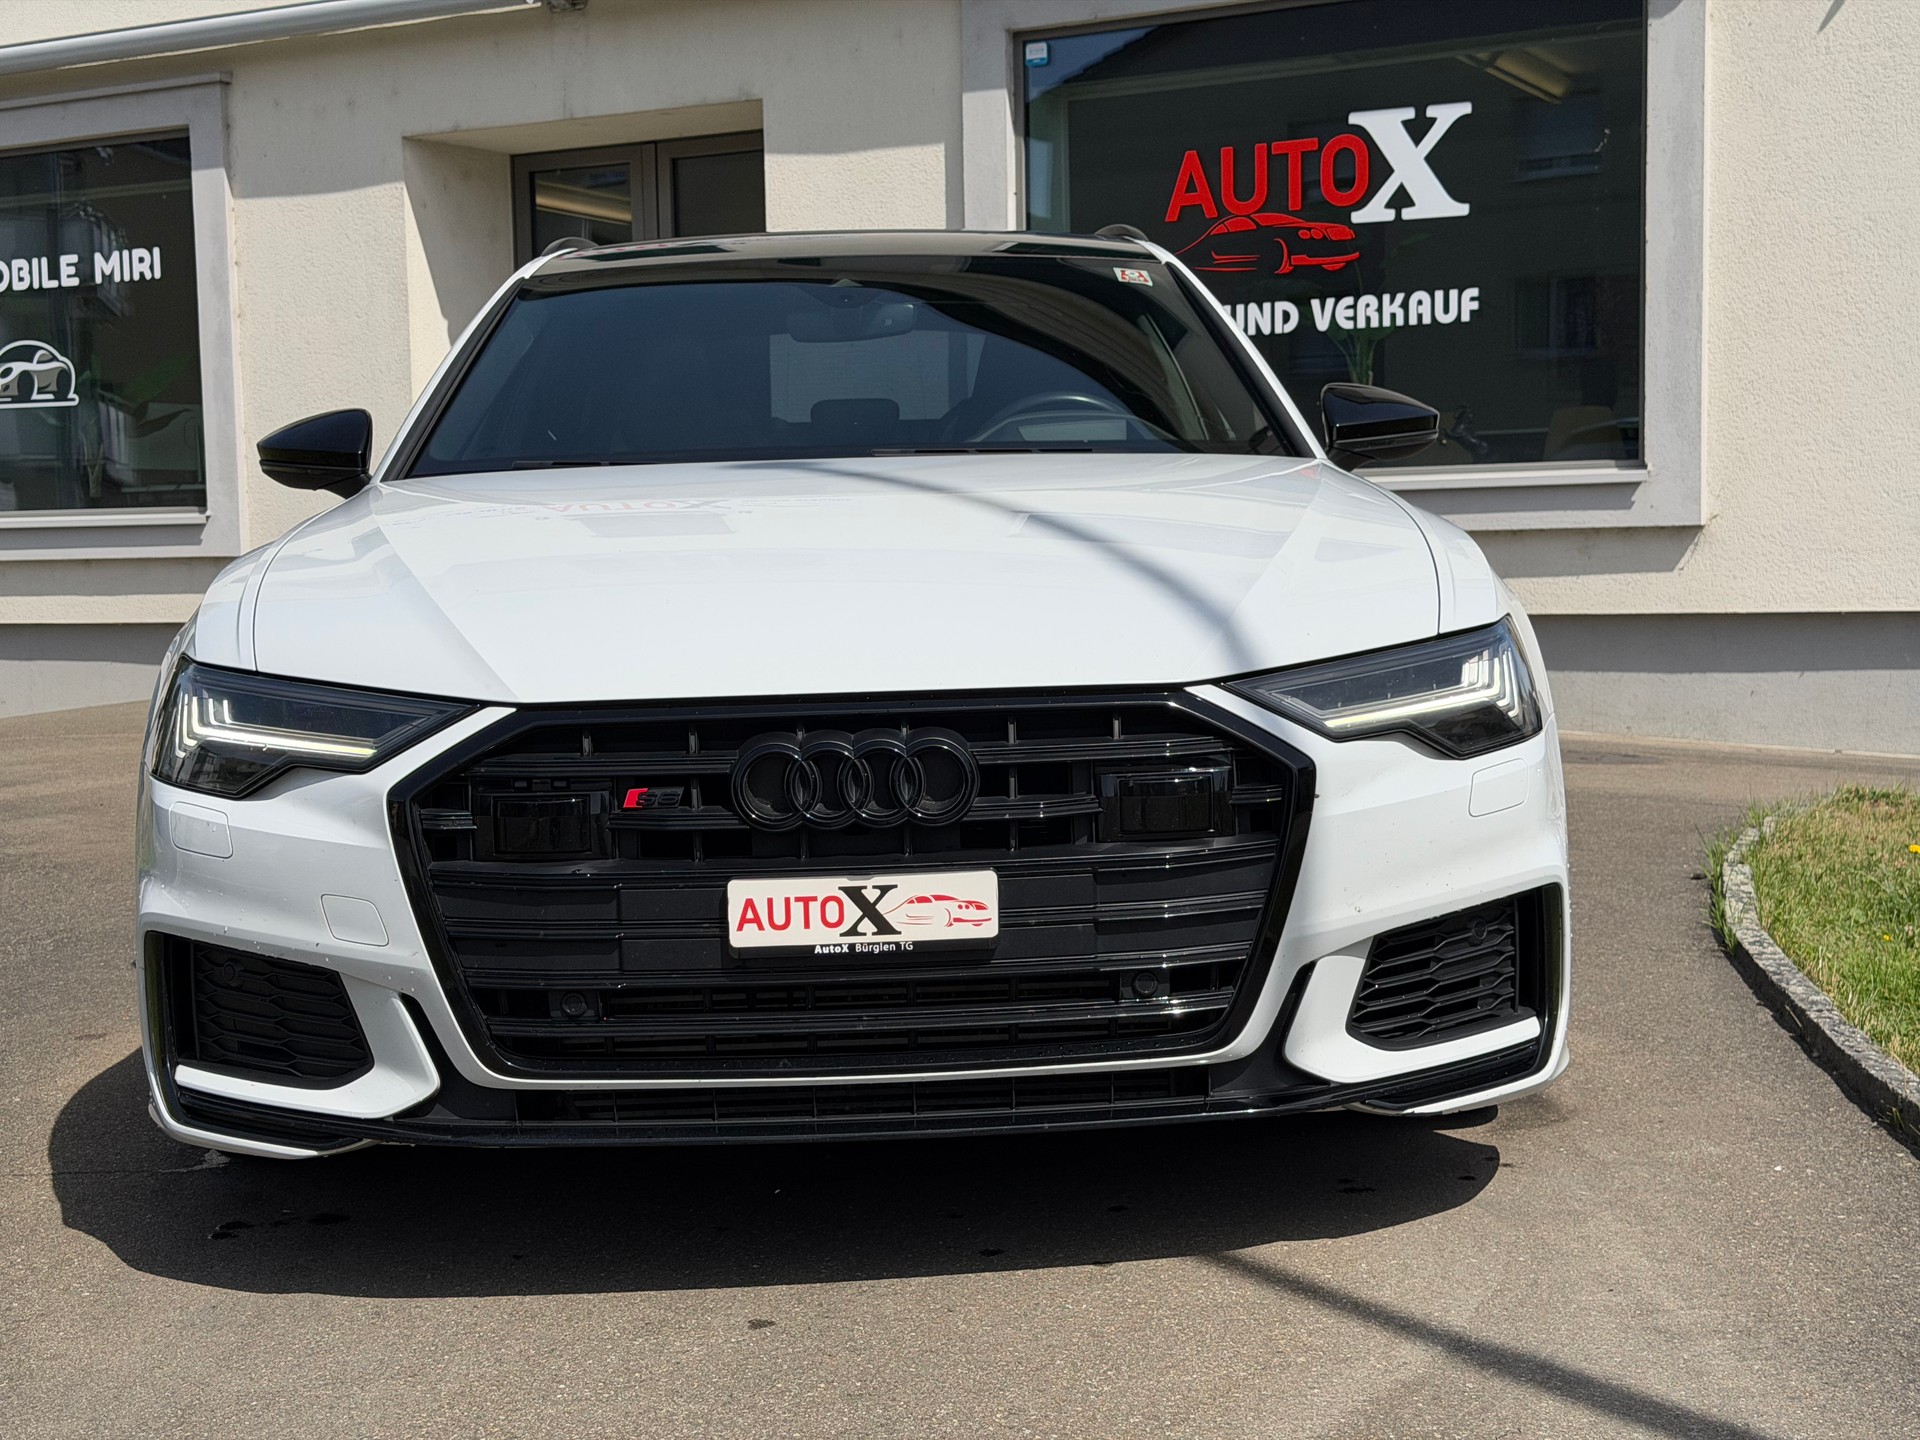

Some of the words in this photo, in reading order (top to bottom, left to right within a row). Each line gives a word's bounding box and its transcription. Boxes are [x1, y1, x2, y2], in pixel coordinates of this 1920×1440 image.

[94, 246, 161, 285] MIRI
[1310, 287, 1479, 332] VERKAUF
[814, 945, 849, 954] AutoX
[855, 942, 896, 954] Bürglen
[900, 942, 914, 951] TG
